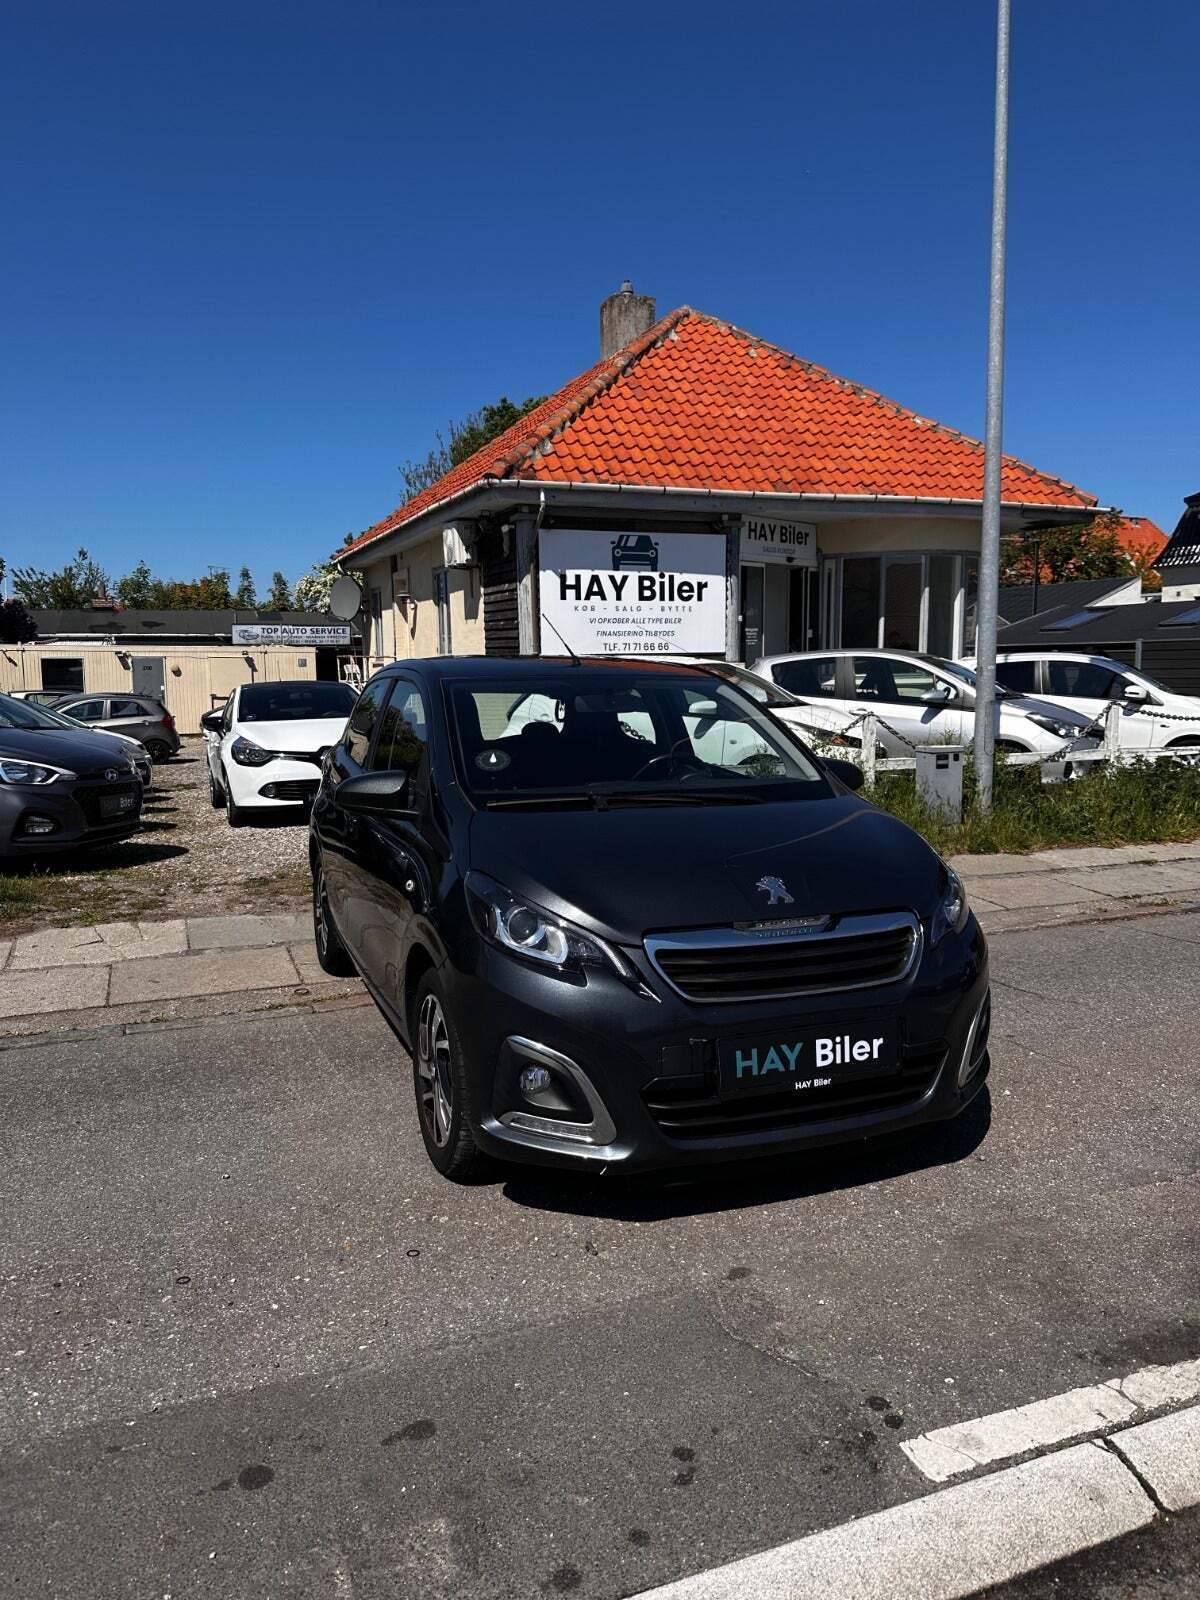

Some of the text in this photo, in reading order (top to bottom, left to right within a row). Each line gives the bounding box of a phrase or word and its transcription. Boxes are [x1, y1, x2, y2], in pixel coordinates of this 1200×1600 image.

[748, 521, 809, 546] HAY Biler
[560, 572, 708, 602] HAY Biler
[603, 643, 669, 652] TLF. 71 71 66 66
[735, 1035, 884, 1078] HAY Biler
[795, 1078, 832, 1090] HAY Biler
